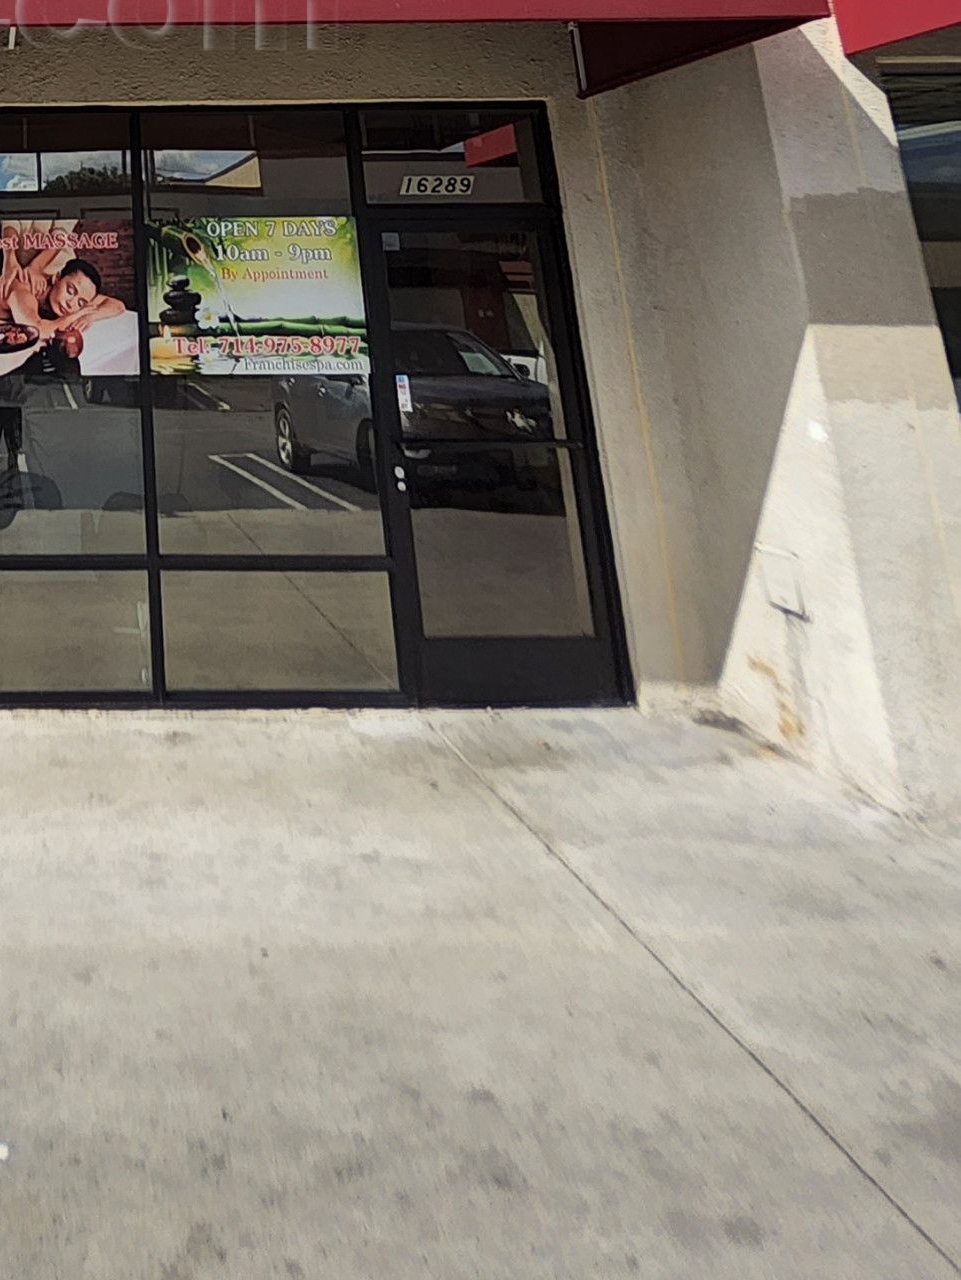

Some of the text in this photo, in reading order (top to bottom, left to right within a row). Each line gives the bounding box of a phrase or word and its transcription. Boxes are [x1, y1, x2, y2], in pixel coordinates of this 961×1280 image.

[404, 177, 472, 194] 16289
[206, 220, 338, 237] OPEN 7 DAYS
[23, 231, 119, 250] MASSAGE
[215, 243, 270, 262] 10am
[288, 242, 333, 264] 9pm
[221, 267, 329, 282] By Appointment
[218, 335, 362, 356] 714-975-8977
